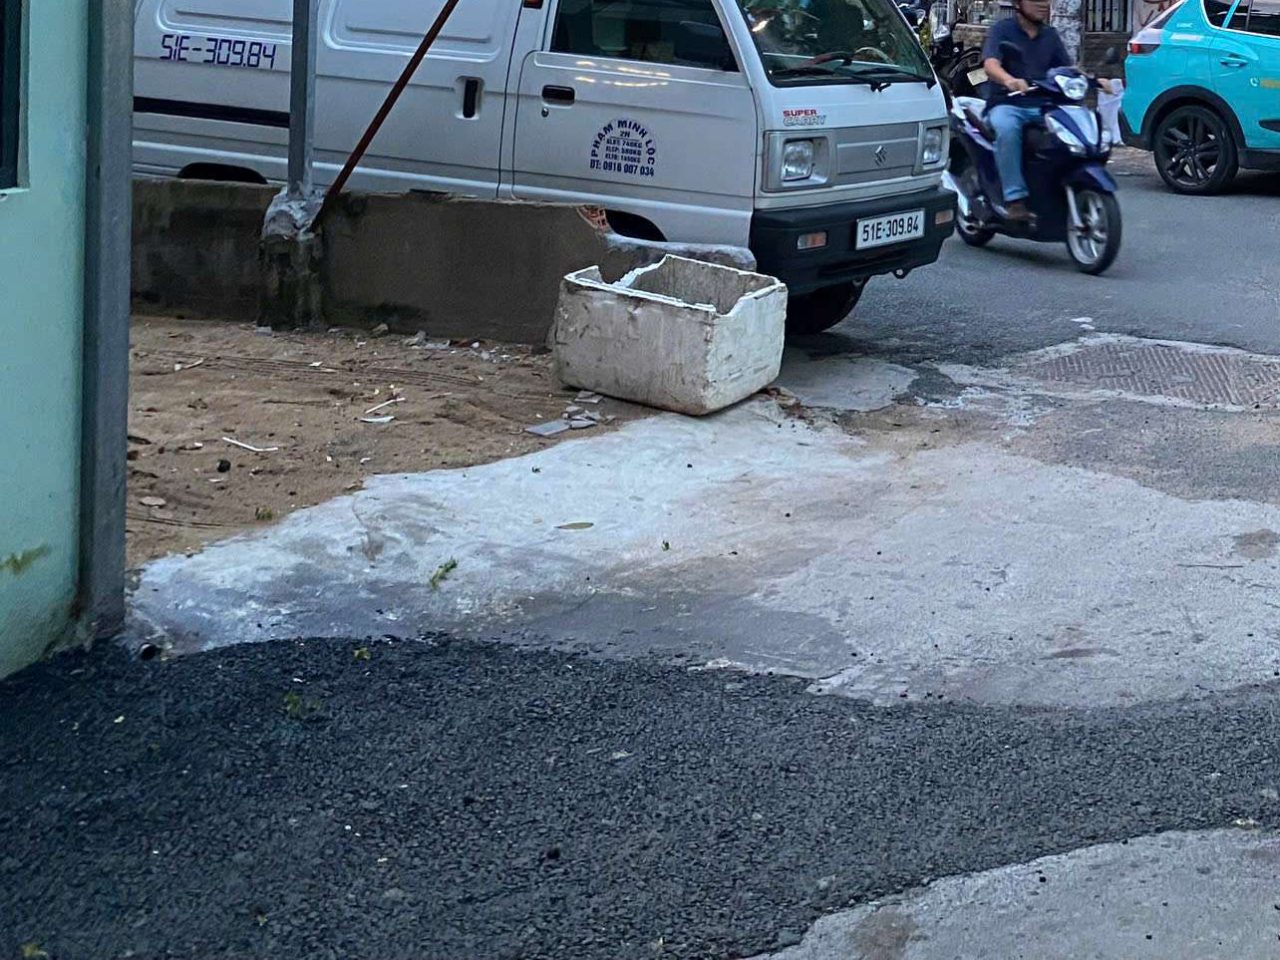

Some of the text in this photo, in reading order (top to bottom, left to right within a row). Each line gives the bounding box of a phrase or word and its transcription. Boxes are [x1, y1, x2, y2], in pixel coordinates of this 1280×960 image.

[160, 34, 276, 68] 51E-309.84
[783, 109, 817, 117] SUPER
[617, 120, 648, 138] MINH
[623, 164, 638, 174] 007
[862, 215, 919, 242] 51E-309.84
